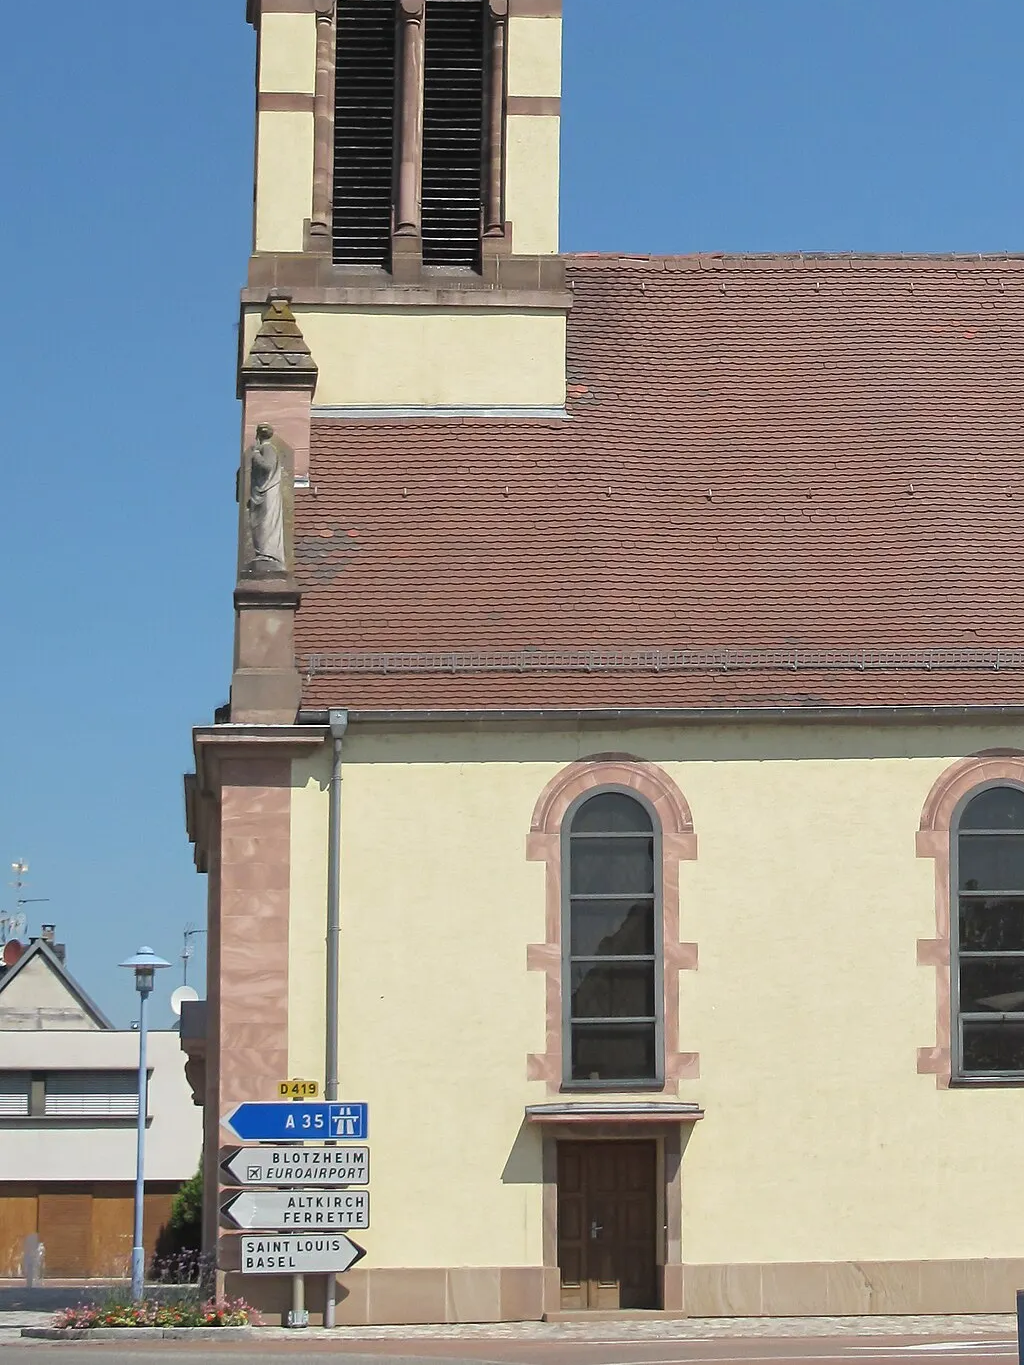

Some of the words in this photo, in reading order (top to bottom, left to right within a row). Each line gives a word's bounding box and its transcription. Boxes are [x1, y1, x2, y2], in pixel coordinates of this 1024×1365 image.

[285, 1114, 295, 1129] A
[302, 1114, 324, 1129] 35
[272, 1152, 364, 1164] BLOTZHEIM
[266, 1167, 365, 1179] EUROAIRPORT
[287, 1196, 364, 1208] ALTKIRCH
[283, 1211, 364, 1223] FERRETTE
[246, 1241, 290, 1253] SAINT
[296, 1240, 340, 1252] LOUIS
[246, 1256, 296, 1268] BASEL
